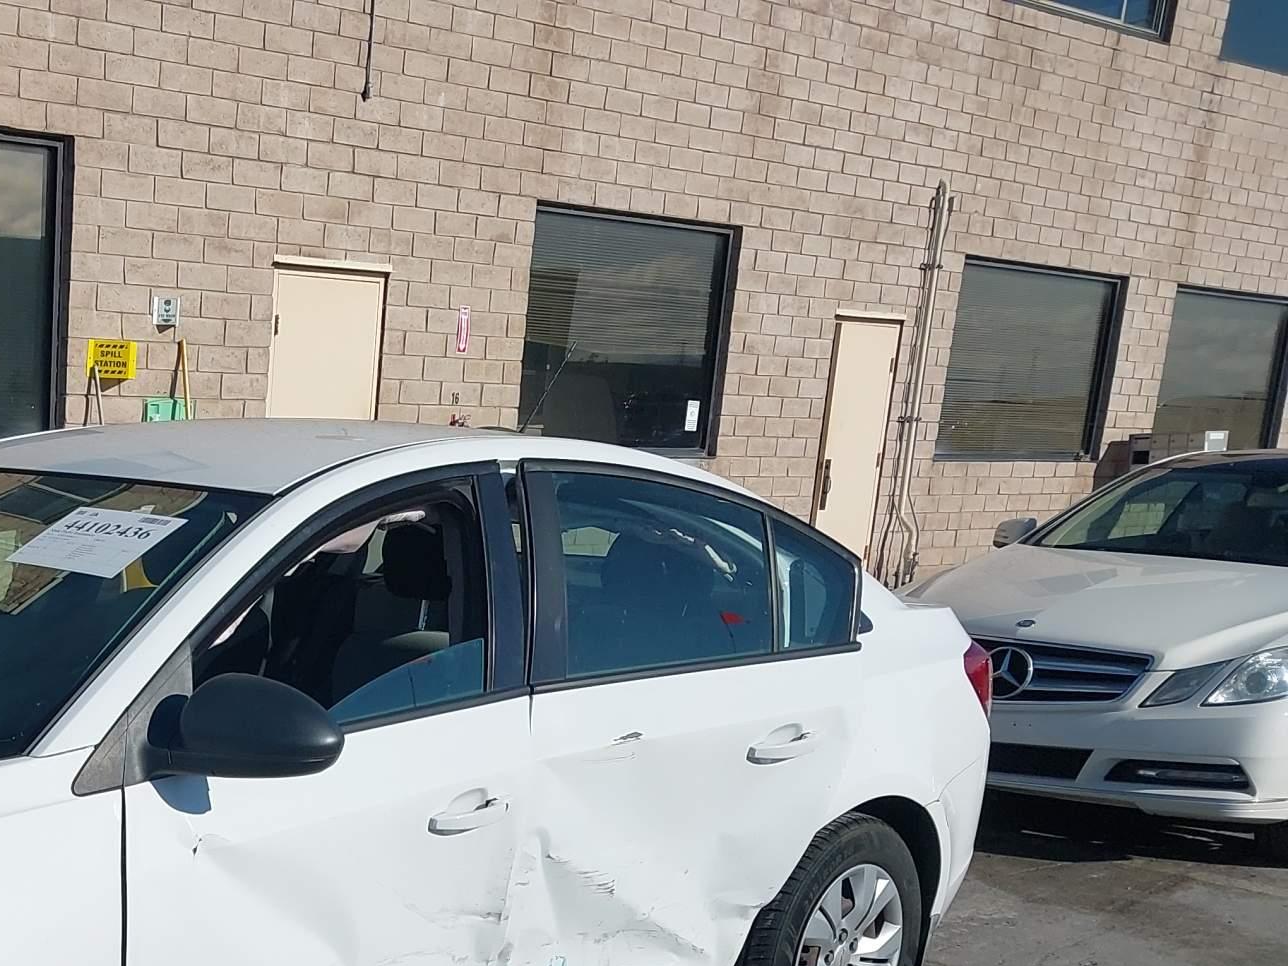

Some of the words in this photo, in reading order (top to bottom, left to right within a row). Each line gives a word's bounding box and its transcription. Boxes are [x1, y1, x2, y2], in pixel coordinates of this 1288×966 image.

[100, 350, 122, 358] SPILL
[94, 360, 127, 368] STATION
[452, 392, 460, 405] 16
[64, 519, 153, 541] 44102436
